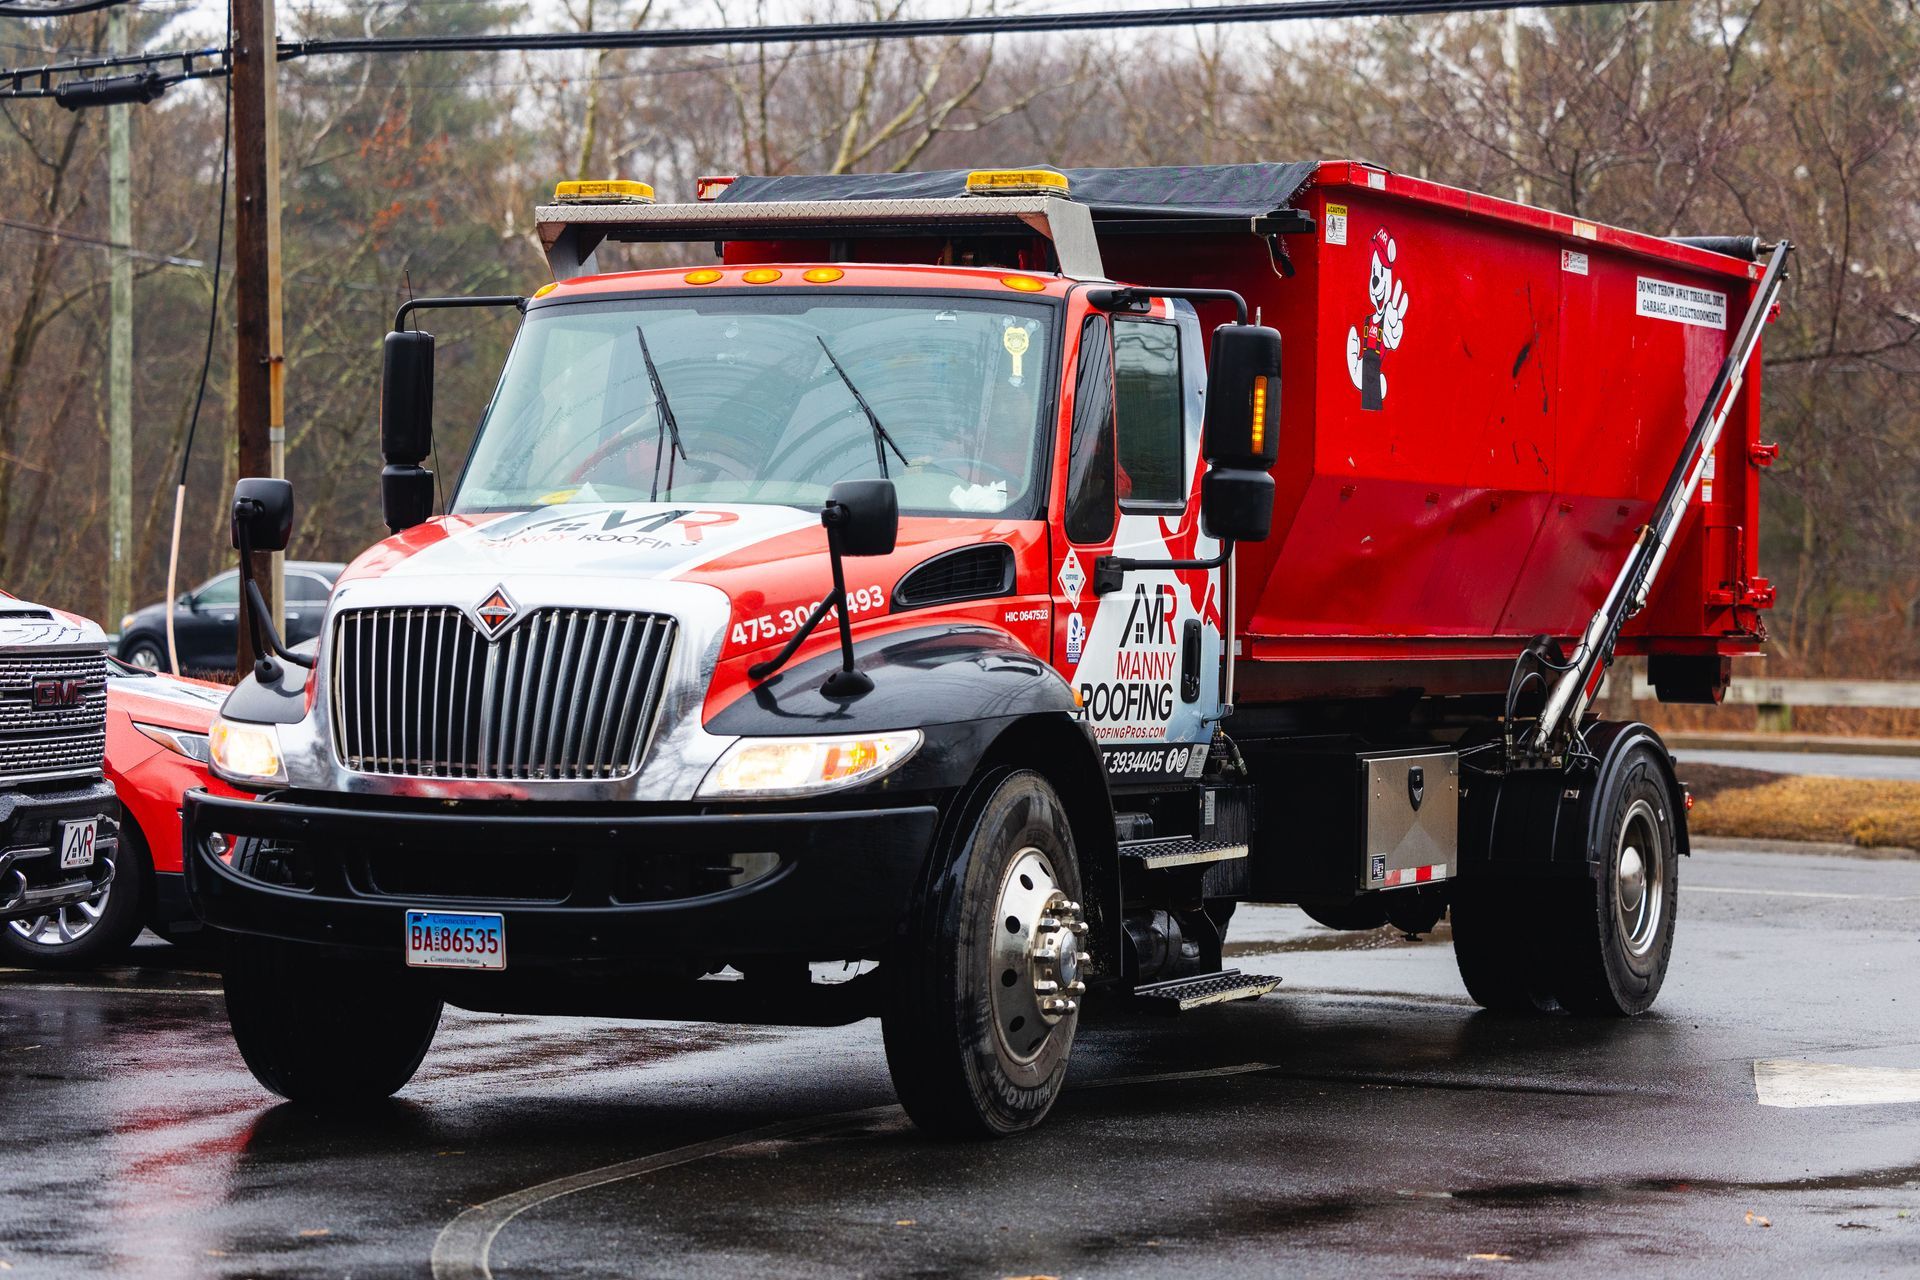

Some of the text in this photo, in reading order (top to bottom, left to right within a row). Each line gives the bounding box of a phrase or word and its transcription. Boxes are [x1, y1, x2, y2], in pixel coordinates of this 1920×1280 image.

[1638, 280, 1646, 292] DO
[1646, 282, 1657, 295] NOT
[1658, 284, 1675, 298] THROW
[1675, 288, 1689, 301] AWAY
[1668, 305, 1679, 317] AND
[1679, 306, 1722, 324] ELECTRODOMESTIC
[1005, 612, 1019, 622] HIC
[1068, 642, 1080, 652] BBB
[1116, 651, 1177, 681] MANNY
[34, 680, 86, 706] GMC
[1081, 683, 1174, 721] ROOFING
[1109, 751, 1165, 773] 3934405
[433, 916, 477, 926] Connecticut
[412, 925, 433, 951] BA
[441, 927, 499, 954] 86535
